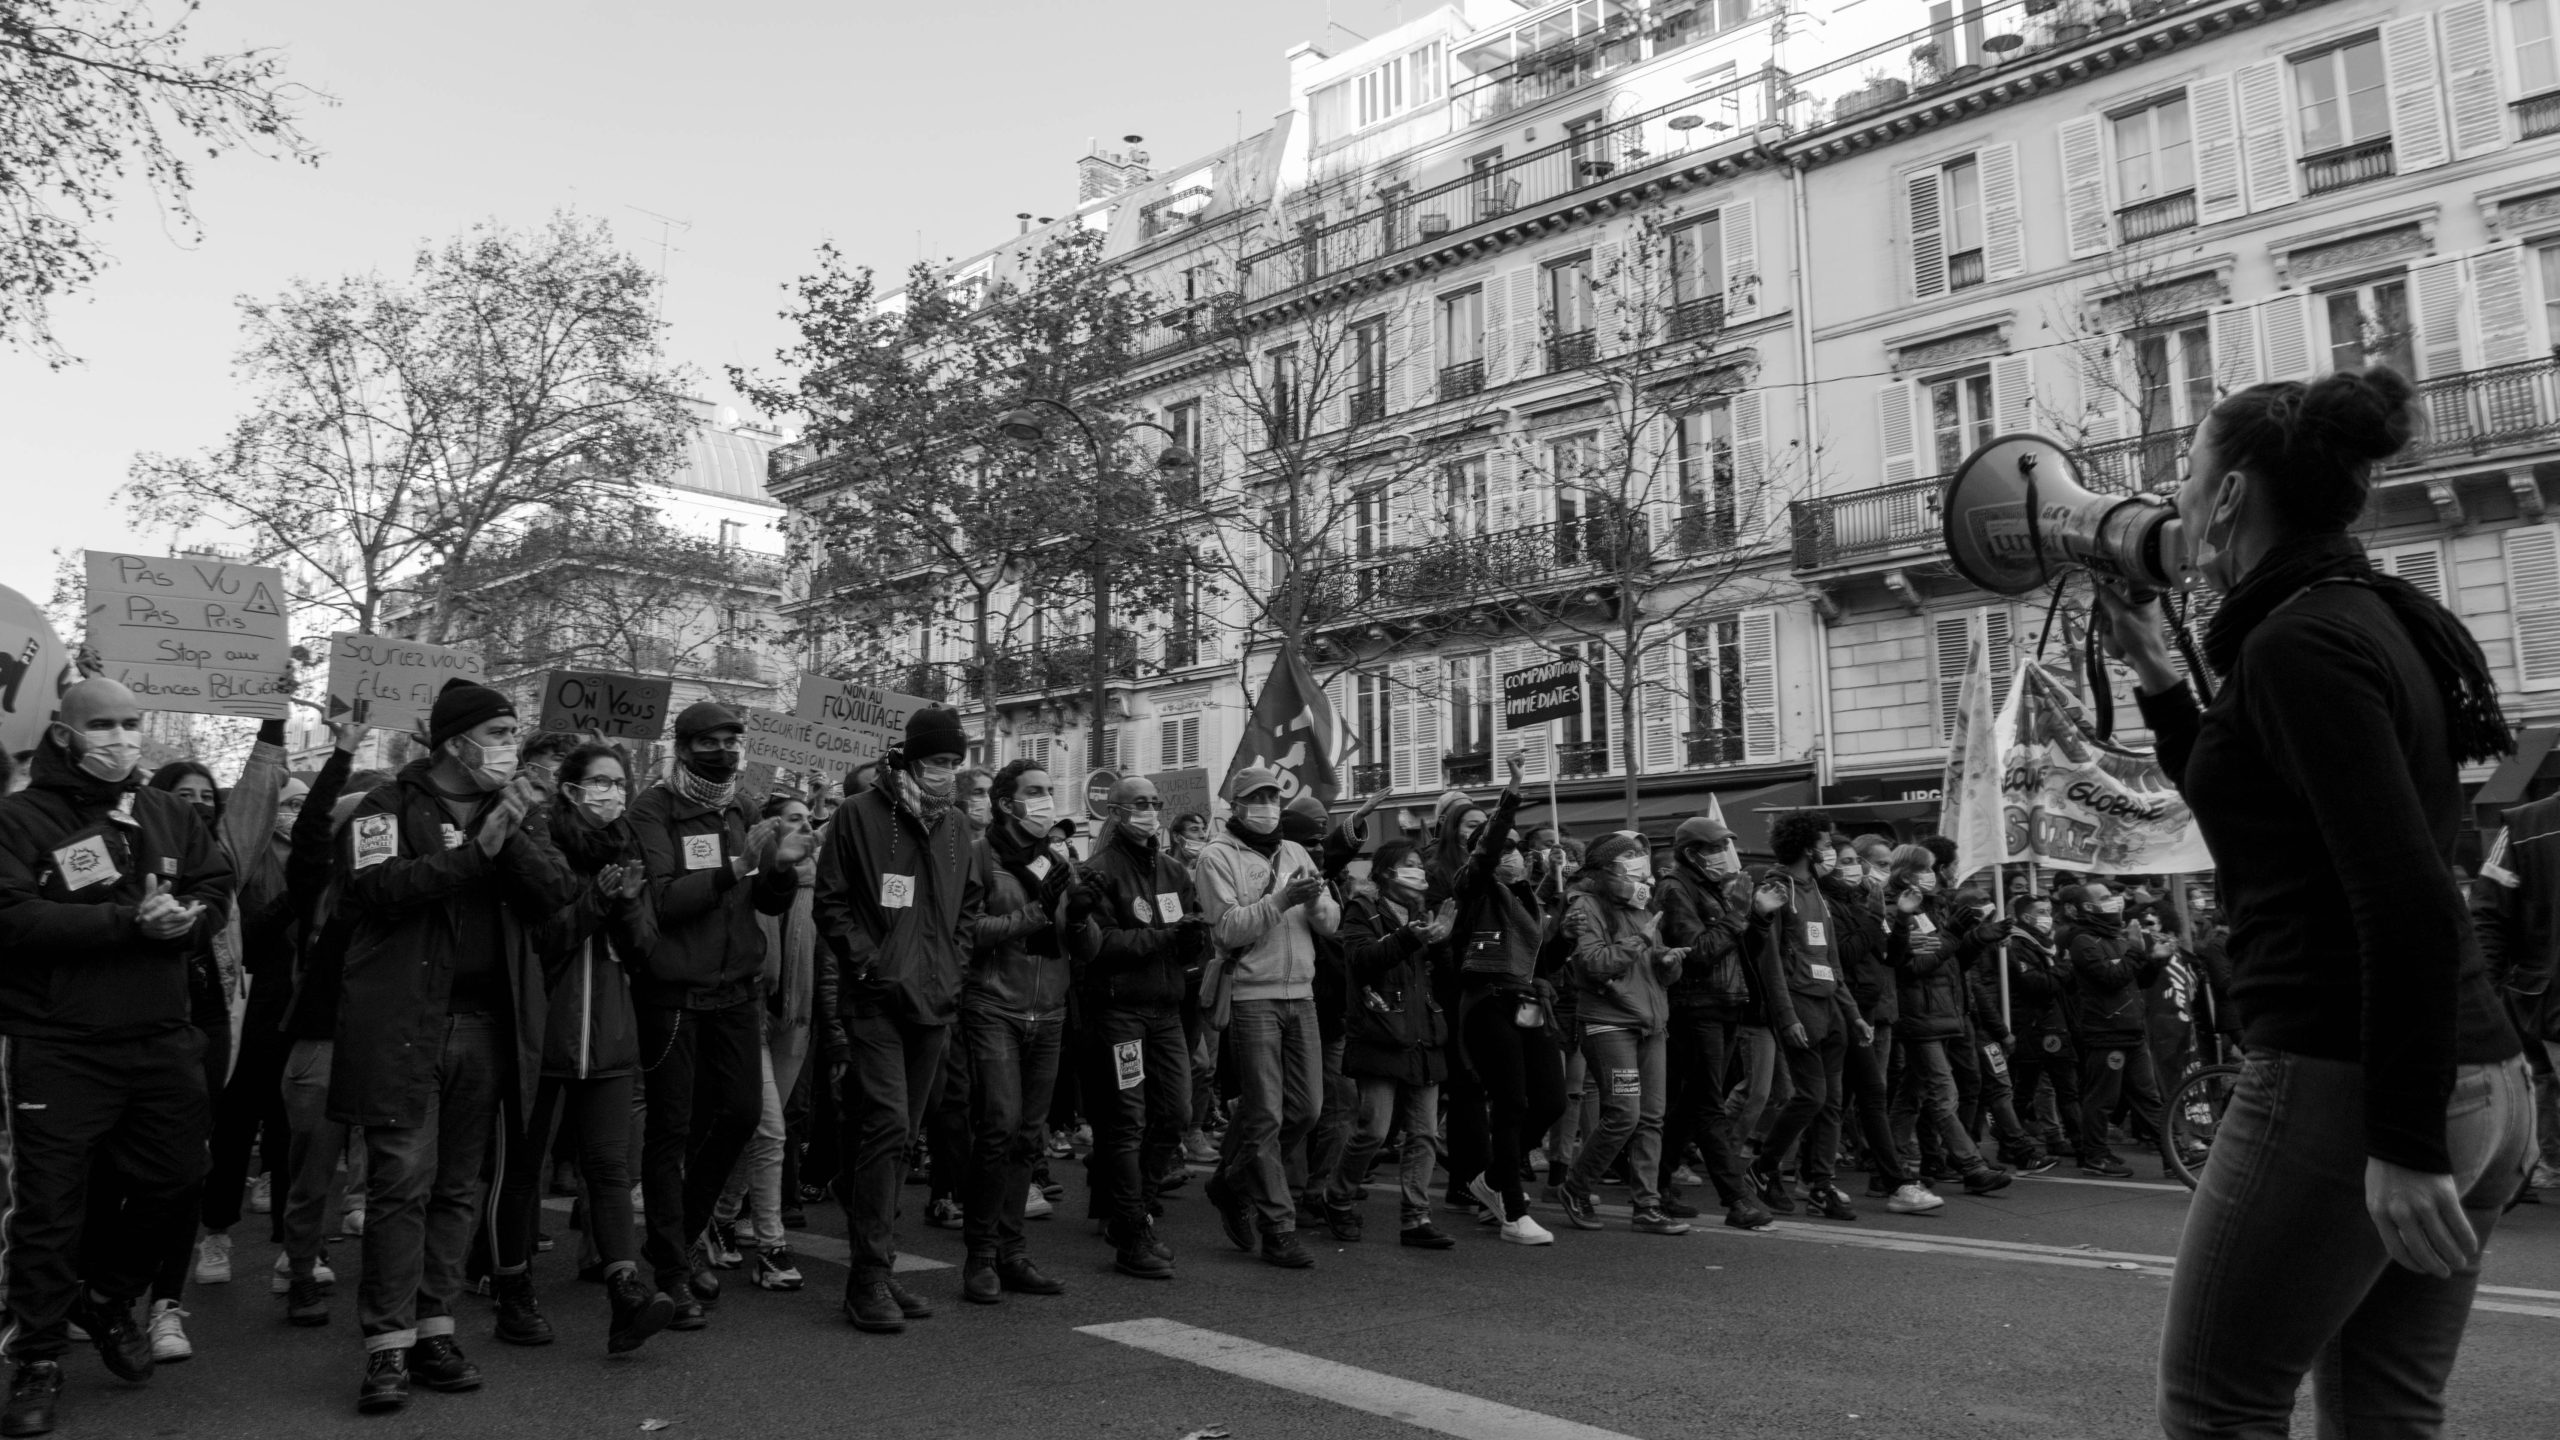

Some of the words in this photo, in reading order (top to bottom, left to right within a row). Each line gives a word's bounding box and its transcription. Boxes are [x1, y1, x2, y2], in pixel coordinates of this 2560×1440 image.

[192, 565, 240, 595] VU
[155, 639, 211, 669] Stop
[224, 650, 260, 661] aux
[431, 653, 480, 674] vous
[843, 684, 867, 700] NON
[868, 690, 884, 705] AU
[572, 713, 633, 734] VOIT
[815, 731, 877, 759] GLOBALE
